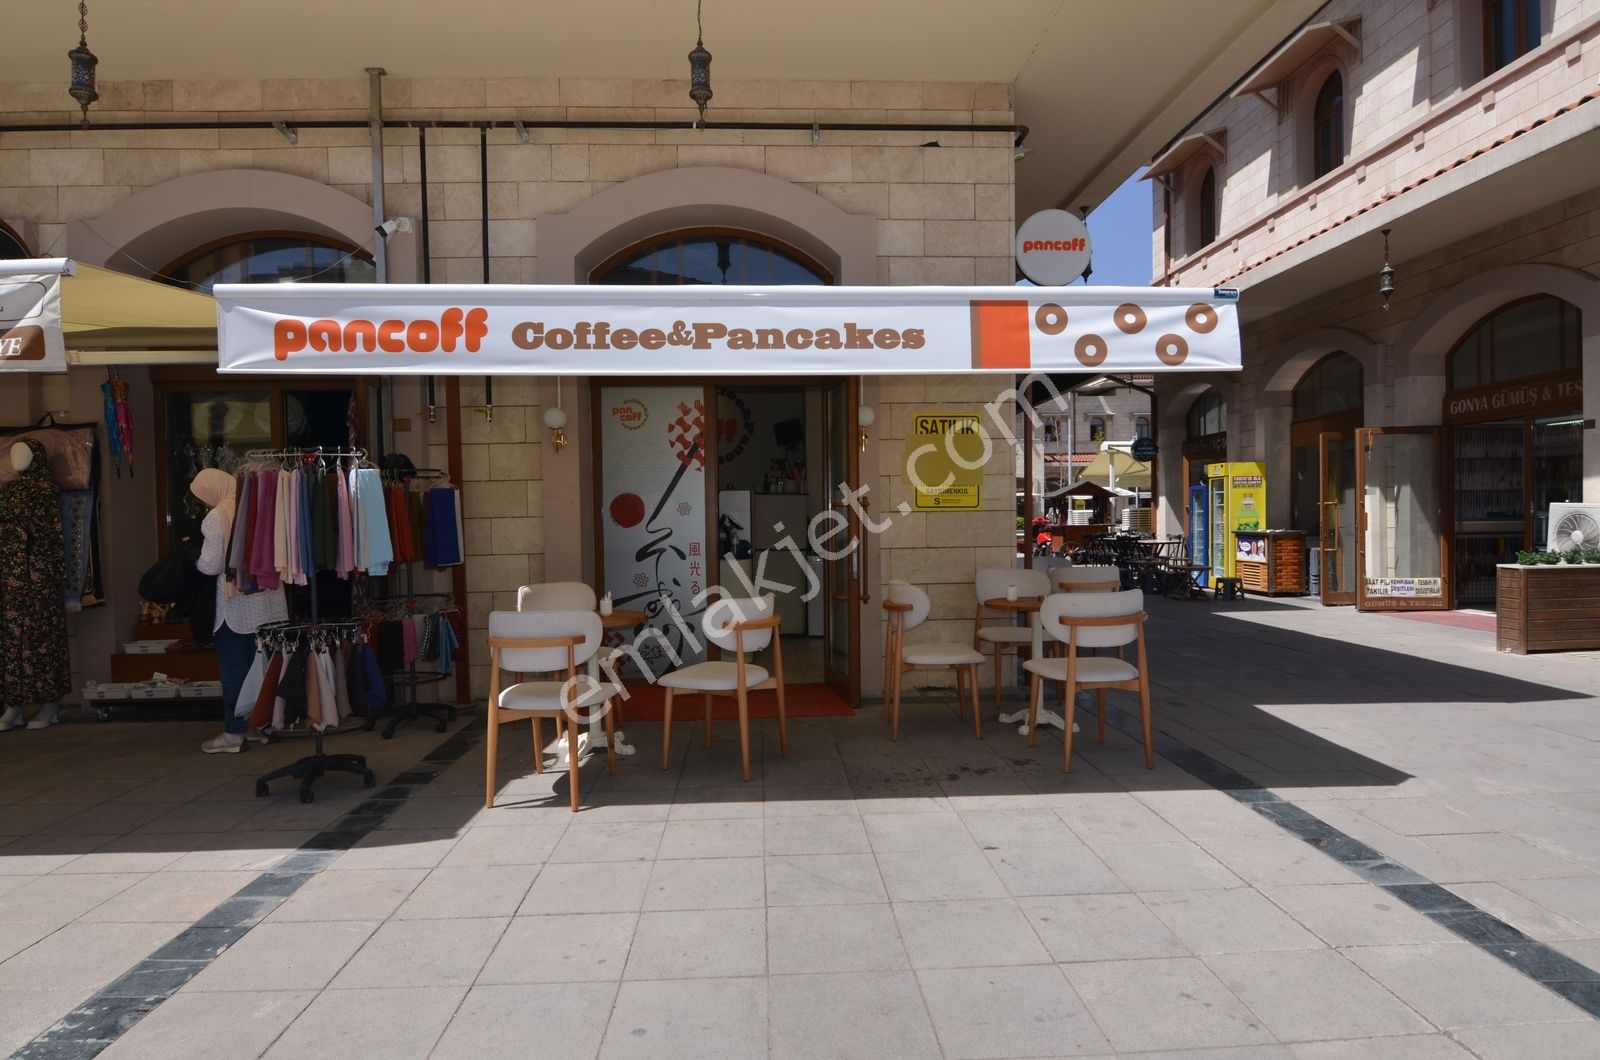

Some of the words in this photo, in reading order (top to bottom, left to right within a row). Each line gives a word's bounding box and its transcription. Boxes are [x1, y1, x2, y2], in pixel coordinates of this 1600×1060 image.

[1023, 237, 1086, 253] pancoff
[274, 307, 488, 361] pancoff
[511, 320, 926, 350] Coffee&Pancakes
[1492, 386, 1537, 408] GÜMÜŞ
[1542, 386, 1552, 401] &
[612, 407, 632, 416] pan
[689, 542, 701, 595] 風光る
